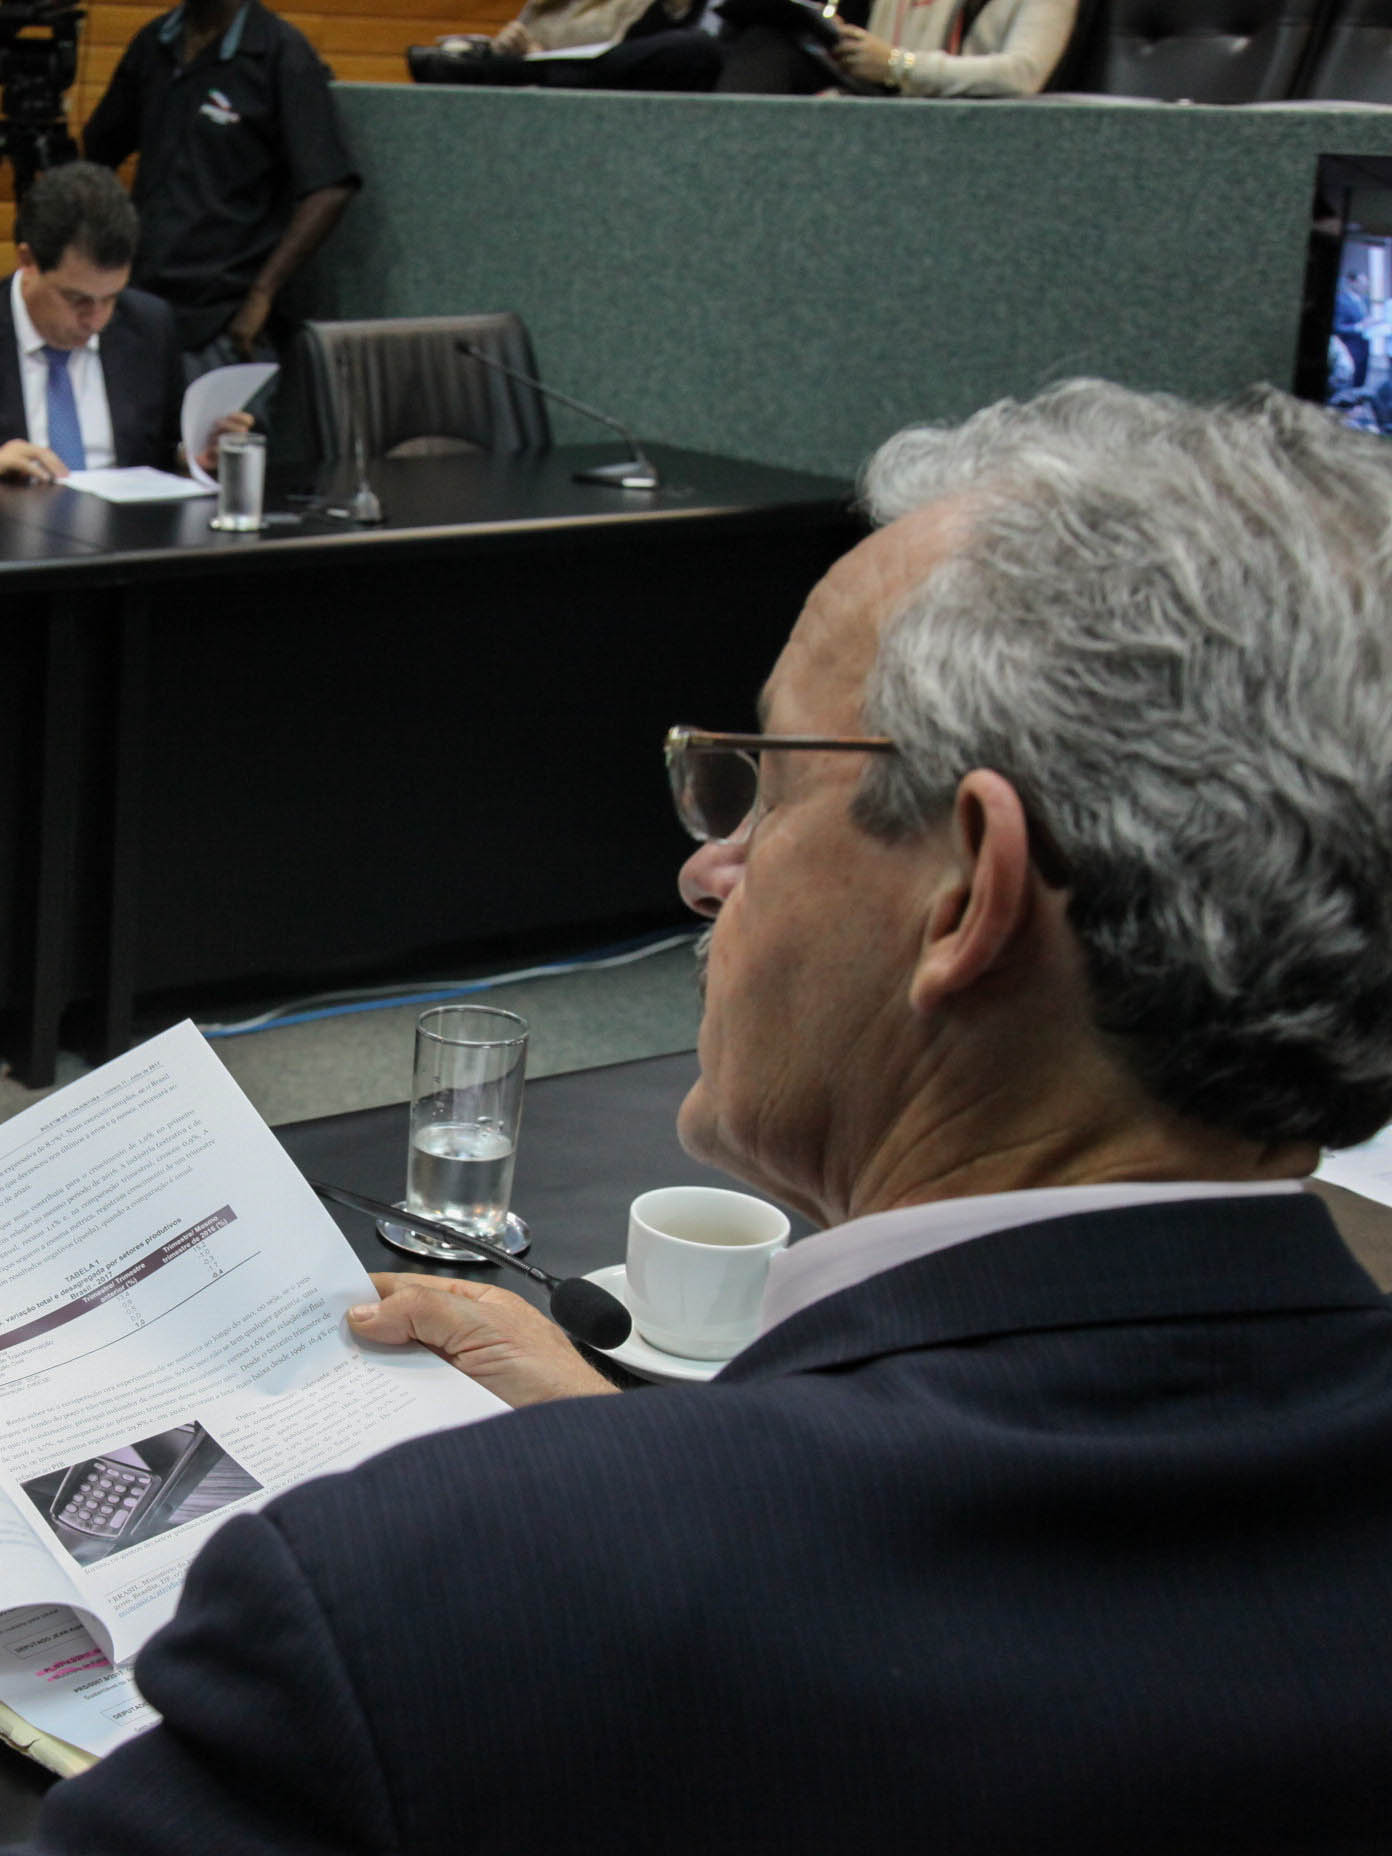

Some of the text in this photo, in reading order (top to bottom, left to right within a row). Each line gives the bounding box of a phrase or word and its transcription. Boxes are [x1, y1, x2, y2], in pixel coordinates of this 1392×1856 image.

[195, 1215, 218, 1233] Mesmo
[162, 1242, 191, 1263] trimestre
[191, 1236, 200, 1245] de
[4, 1305, 37, 1323] variação
[36, 1296, 53, 1308] total
[60, 1266, 105, 1297] desagregada
[105, 1259, 118, 1270] por
[118, 1241, 144, 1261] setores
[145, 1217, 182, 1245] produtivos
[65, 1262, 94, 1283] TABELA
[116, 1263, 145, 1283] Trimestre
[211, 1268, 224, 1279] -0,4
[70, 1284, 92, 1300] Brasil
[97, 1271, 113, 1285] 2017
[100, 1277, 138, 1303] anterior (%)
[134, 1318, 146, 1328] 1,0
[240, 1356, 261, 1371] Desde
